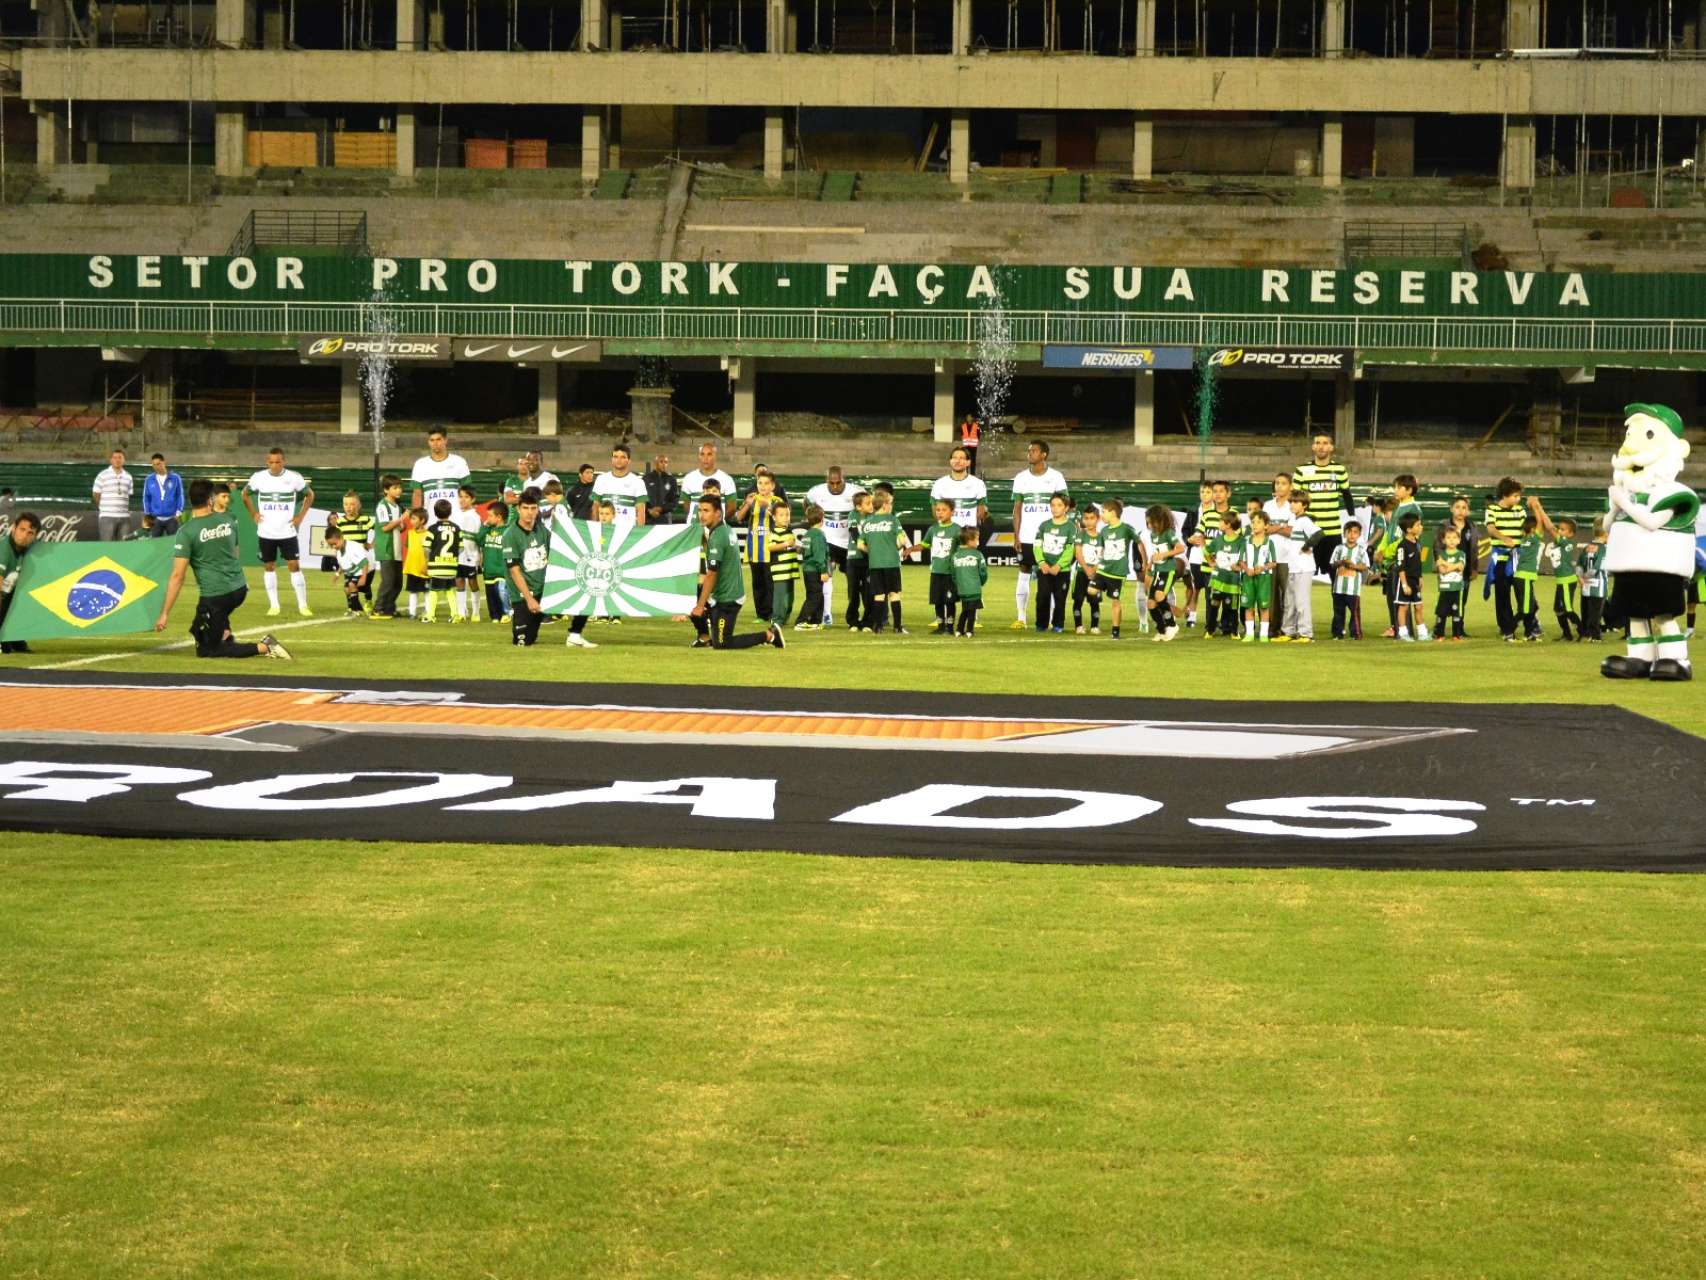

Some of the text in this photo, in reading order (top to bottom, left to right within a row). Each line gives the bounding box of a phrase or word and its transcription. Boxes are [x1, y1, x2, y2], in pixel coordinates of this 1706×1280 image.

[88, 255, 306, 291] SETOR
[372, 257, 498, 292] PRO
[564, 260, 740, 296] TORK
[826, 264, 997, 305] FAÇA
[1063, 267, 1195, 301] SUA
[1261, 269, 1591, 307] RESERVA
[343, 342, 439, 354] PRO TORK
[1081, 352, 1144, 367] NETSHOES
[1243, 353, 1343, 365] PRO TORK
[440, 530, 454, 556] 2
